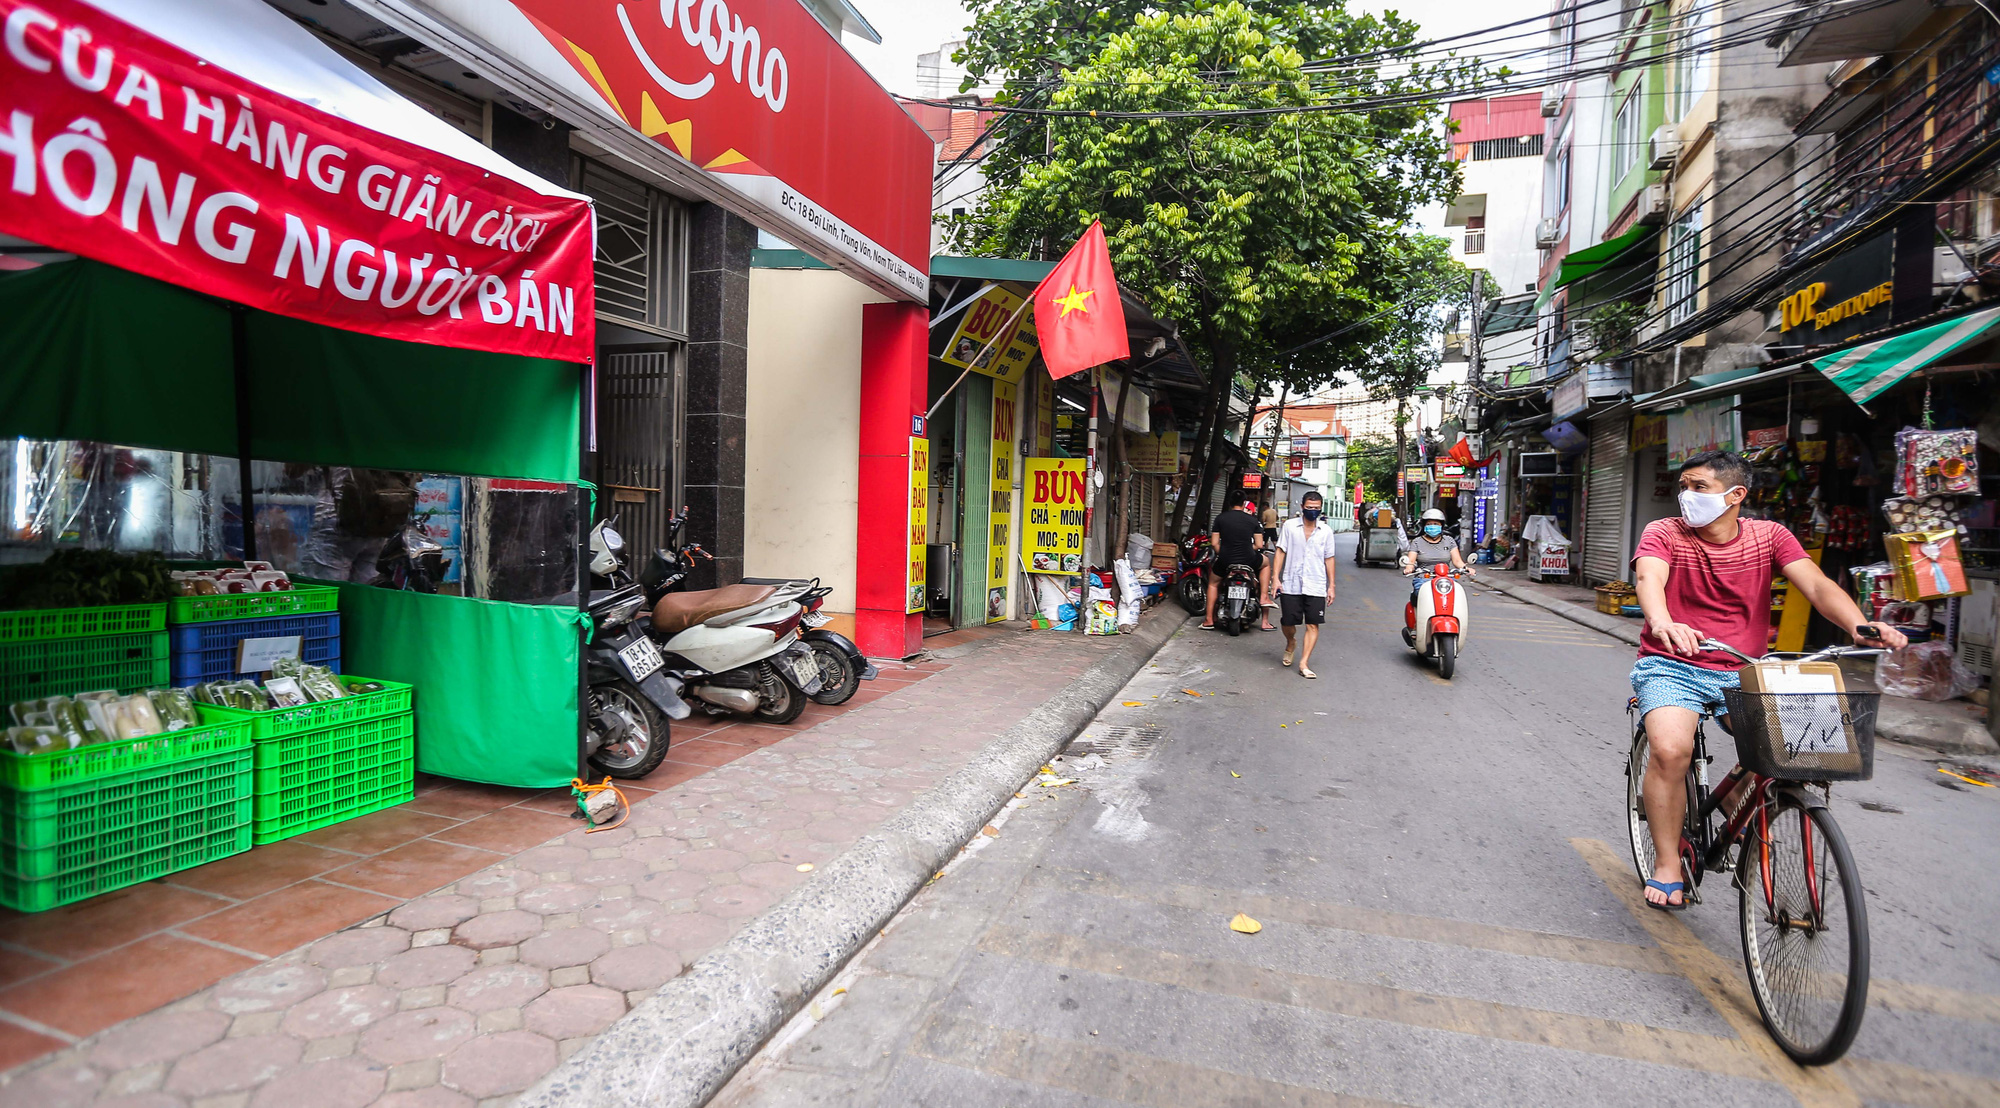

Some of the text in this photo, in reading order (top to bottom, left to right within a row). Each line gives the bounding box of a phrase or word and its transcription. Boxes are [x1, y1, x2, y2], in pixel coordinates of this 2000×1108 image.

[181, 86, 348, 194] HÀNG
[357, 164, 473, 237] GIÃN
[470, 205, 548, 253] CÁCH
[781, 190, 797, 212] ĐC:
[798, 201, 808, 218] 18
[808, 208, 822, 229] Đại
[822, 216, 839, 241] Linh,
[840, 228, 859, 253] Trung
[873, 249, 888, 268] Nam
[915, 278, 925, 293] Nội
[272, 213, 478, 320] NGƯỜI
[478, 269, 574, 337] BÁN
[1778, 281, 1894, 334] TOP BOUTIQUE
[964, 296, 1027, 372] BÚN
[1005, 346, 1026, 362] MỌC
[996, 364, 1010, 376] BÒ
[914, 418, 922, 432] 16
[994, 386, 1016, 443] BÚN
[913, 445, 927, 472] BÚN
[996, 450, 1009, 481] CHẢ
[1033, 460, 1087, 504] BÚN
[992, 486, 1011, 514] MÓNG
[1030, 503, 1049, 525] CHẢ
[1037, 531, 1058, 550] MỌC
[1066, 529, 1080, 550] BÒ
[912, 555, 924, 583] TÔM
[994, 550, 1004, 579] BÒ
